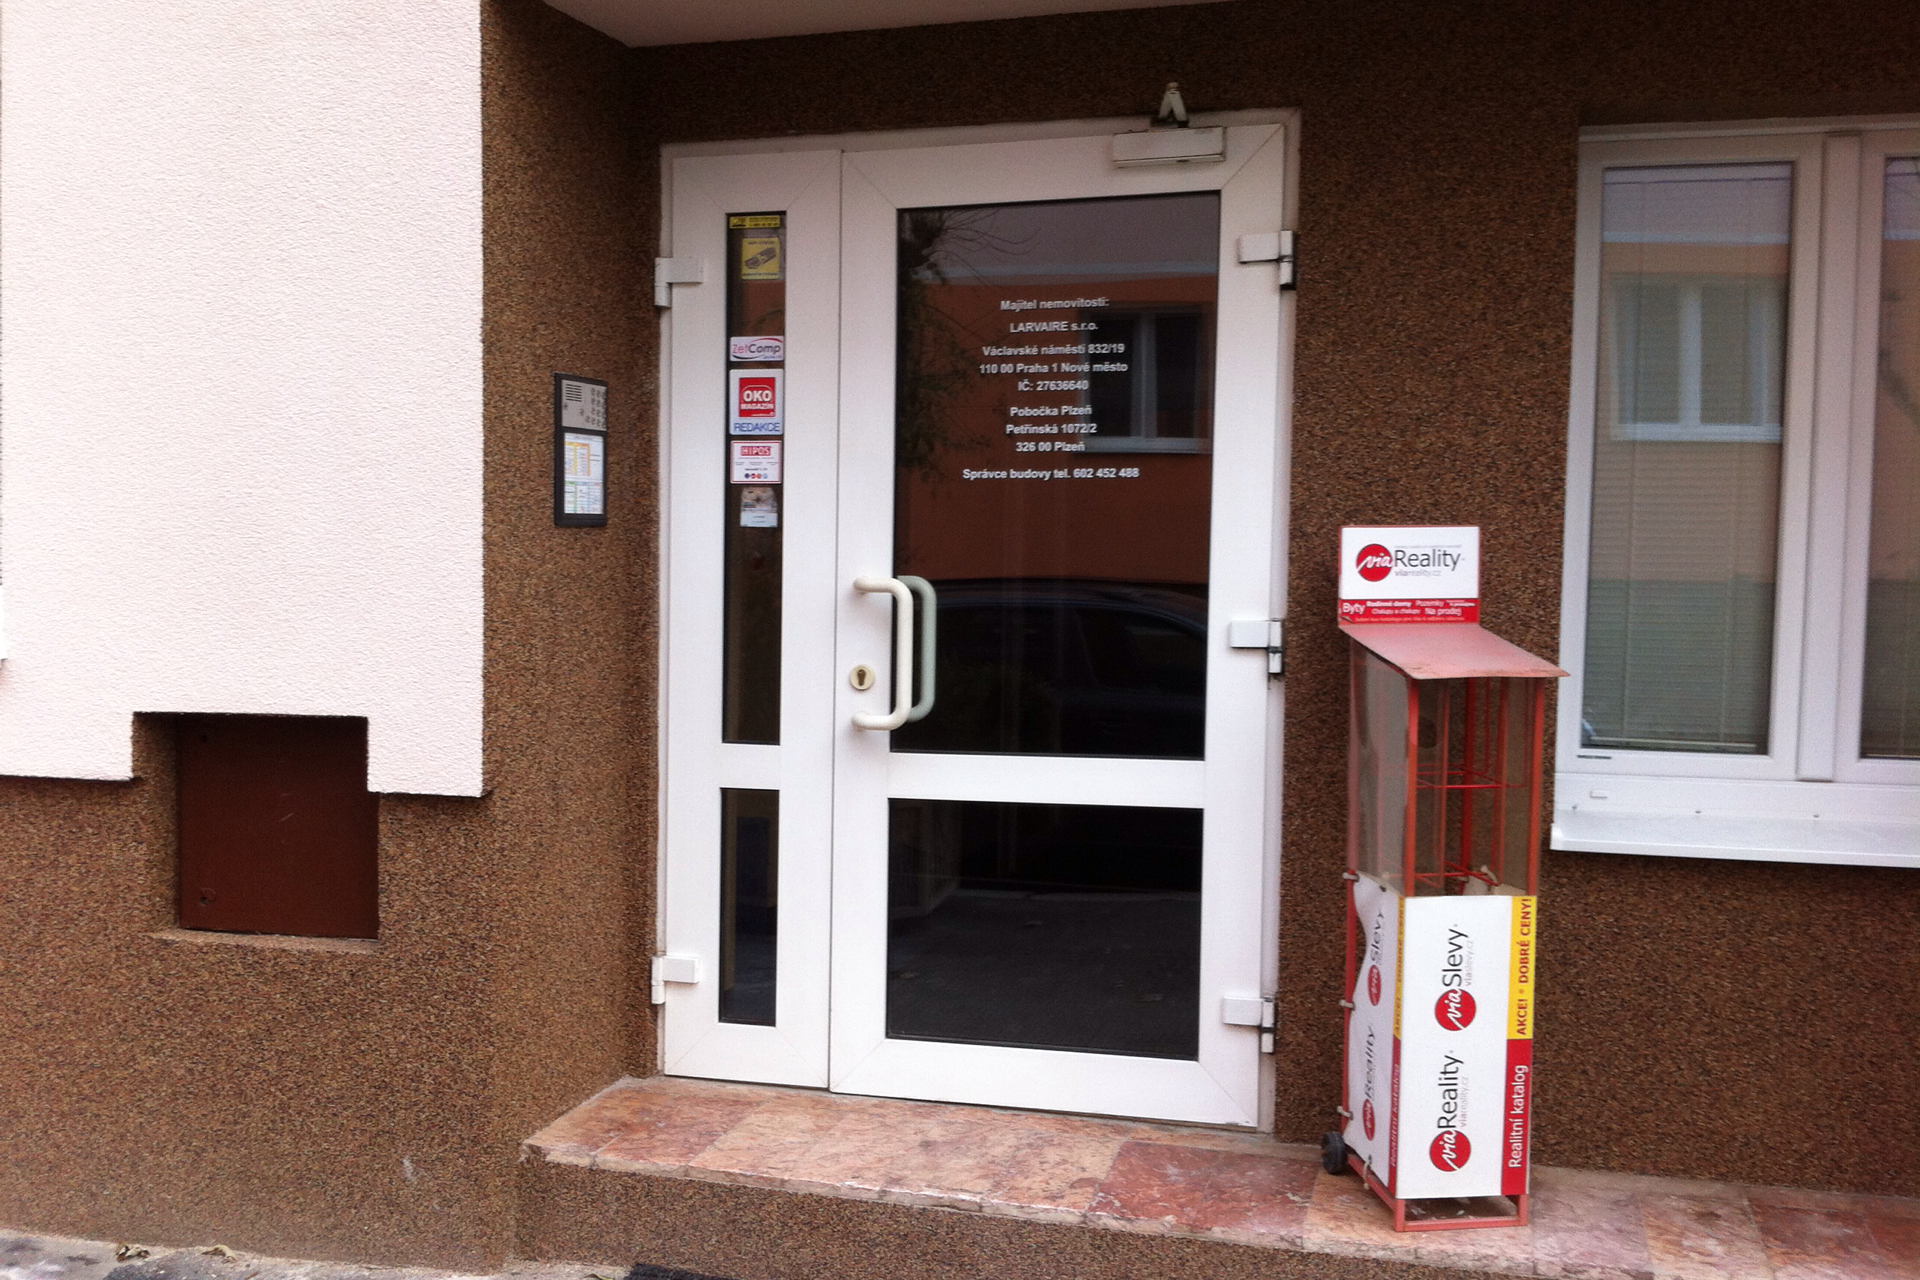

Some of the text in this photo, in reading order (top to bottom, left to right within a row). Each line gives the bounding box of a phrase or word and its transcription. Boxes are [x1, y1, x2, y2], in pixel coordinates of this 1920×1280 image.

[1000, 300, 1037, 313] Majitel
[1010, 321, 1099, 333] LARVAIRE s.r.o.
[982, 343, 1125, 356] Václavské náměstí 832/19
[979, 361, 1129, 374] 110 00 Praha 1 Nové město
[1017, 378, 1034, 391] IČ:
[743, 390, 773, 402] OKO
[1010, 404, 1092, 416] Pobočka Plzeň
[733, 422, 780, 432] REDAKCE
[1006, 423, 1098, 434] Petřínská 1072/2
[1015, 441, 1085, 452] 326 00 Plzeň
[962, 468, 1140, 481] Správce budovy tel. 602 452 488
[1394, 549, 1461, 571] Reality
[1342, 602, 1366, 615] Byty
[1424, 607, 1463, 616] Na prodej
[1442, 927, 1468, 987] Slevy
[1515, 898, 1533, 1036] AKCE! DOBRÉ CENY!
[1437, 1054, 1465, 1129] Reality
[1508, 1064, 1530, 1169] Realitní katalog
